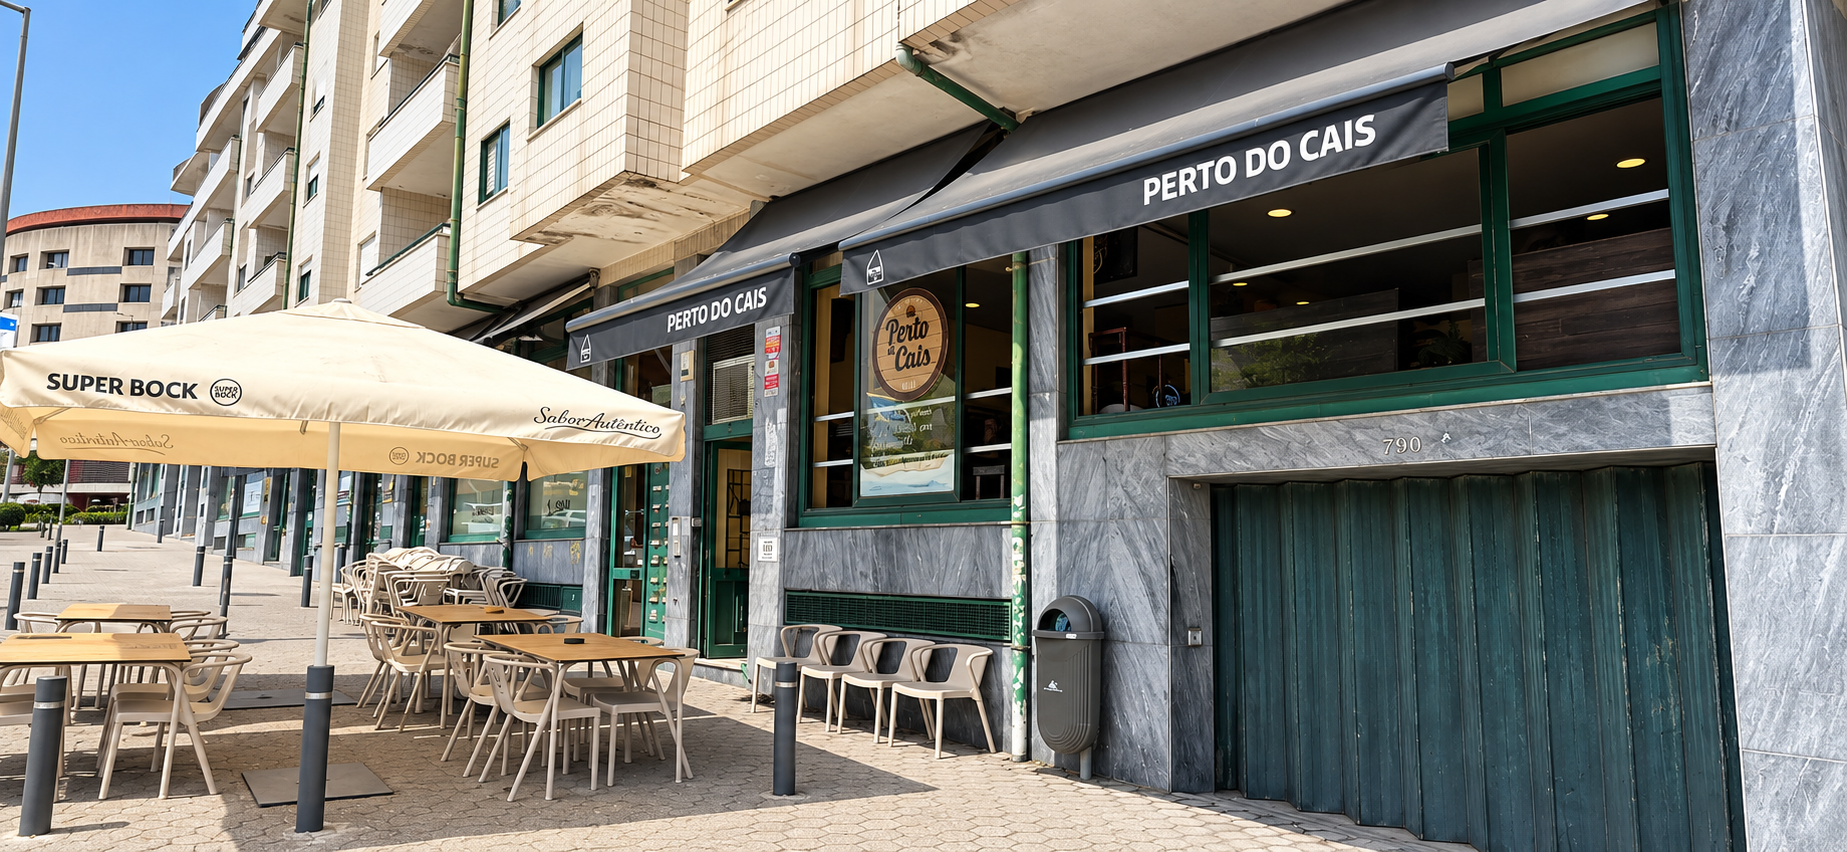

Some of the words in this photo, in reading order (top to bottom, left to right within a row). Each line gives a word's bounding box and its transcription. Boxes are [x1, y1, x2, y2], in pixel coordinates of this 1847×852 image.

[1143, 156, 1237, 206] PERTO
[1245, 139, 1292, 178] DO
[1300, 114, 1376, 162] CAIS
[667, 305, 708, 333] PERTO
[710, 297, 732, 321] DO
[734, 286, 767, 315] CAIS
[885, 316, 930, 346] Perto
[894, 344, 931, 372] Cais
[46, 372, 124, 396] SUPER
[129, 378, 199, 400] BOCK
[214, 385, 239, 393] SUPER
[214, 391, 238, 399] BOCK
[1382, 436, 1422, 456] 790
